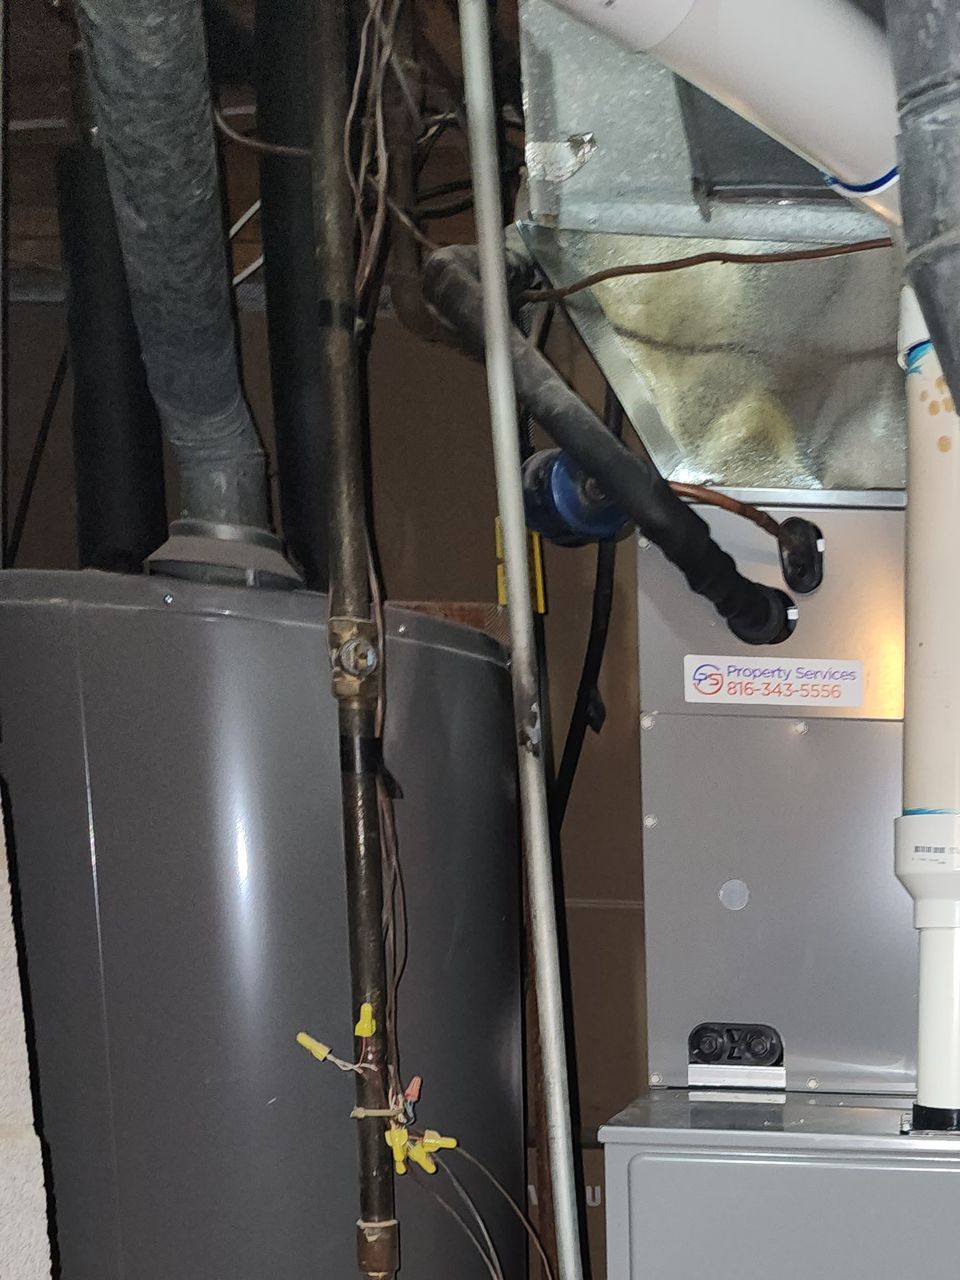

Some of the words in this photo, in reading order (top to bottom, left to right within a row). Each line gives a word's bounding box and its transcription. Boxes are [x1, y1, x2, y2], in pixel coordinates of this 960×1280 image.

[727, 664, 792, 682] Property
[796, 667, 857, 681] Services
[727, 681, 842, 699] 816-343-5556
